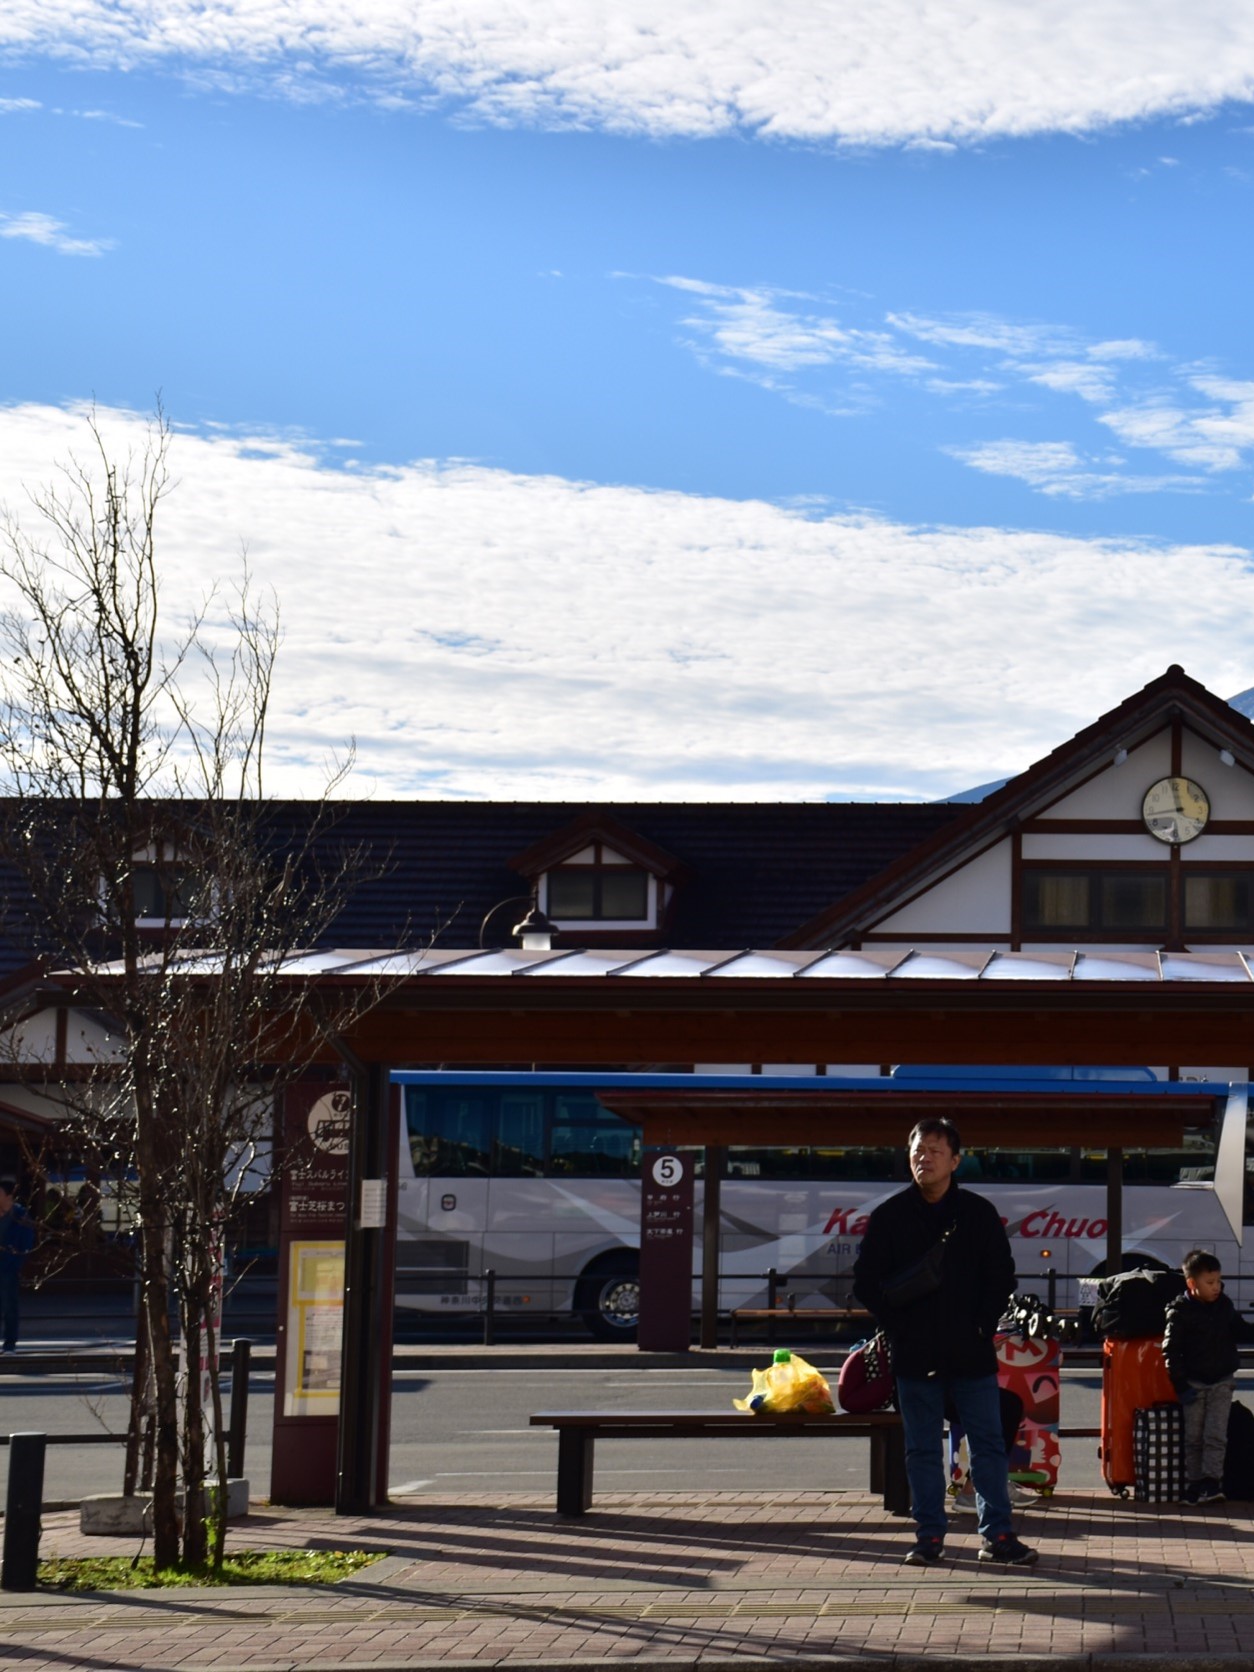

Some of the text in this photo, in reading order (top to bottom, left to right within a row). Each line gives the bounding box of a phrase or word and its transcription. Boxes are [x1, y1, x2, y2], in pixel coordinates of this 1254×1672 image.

[661, 1159, 674, 1178] 5
[1020, 1211, 1108, 1238] Chuo
[827, 1243, 851, 1255] AIR
[1005, 1339, 1043, 1362] M
